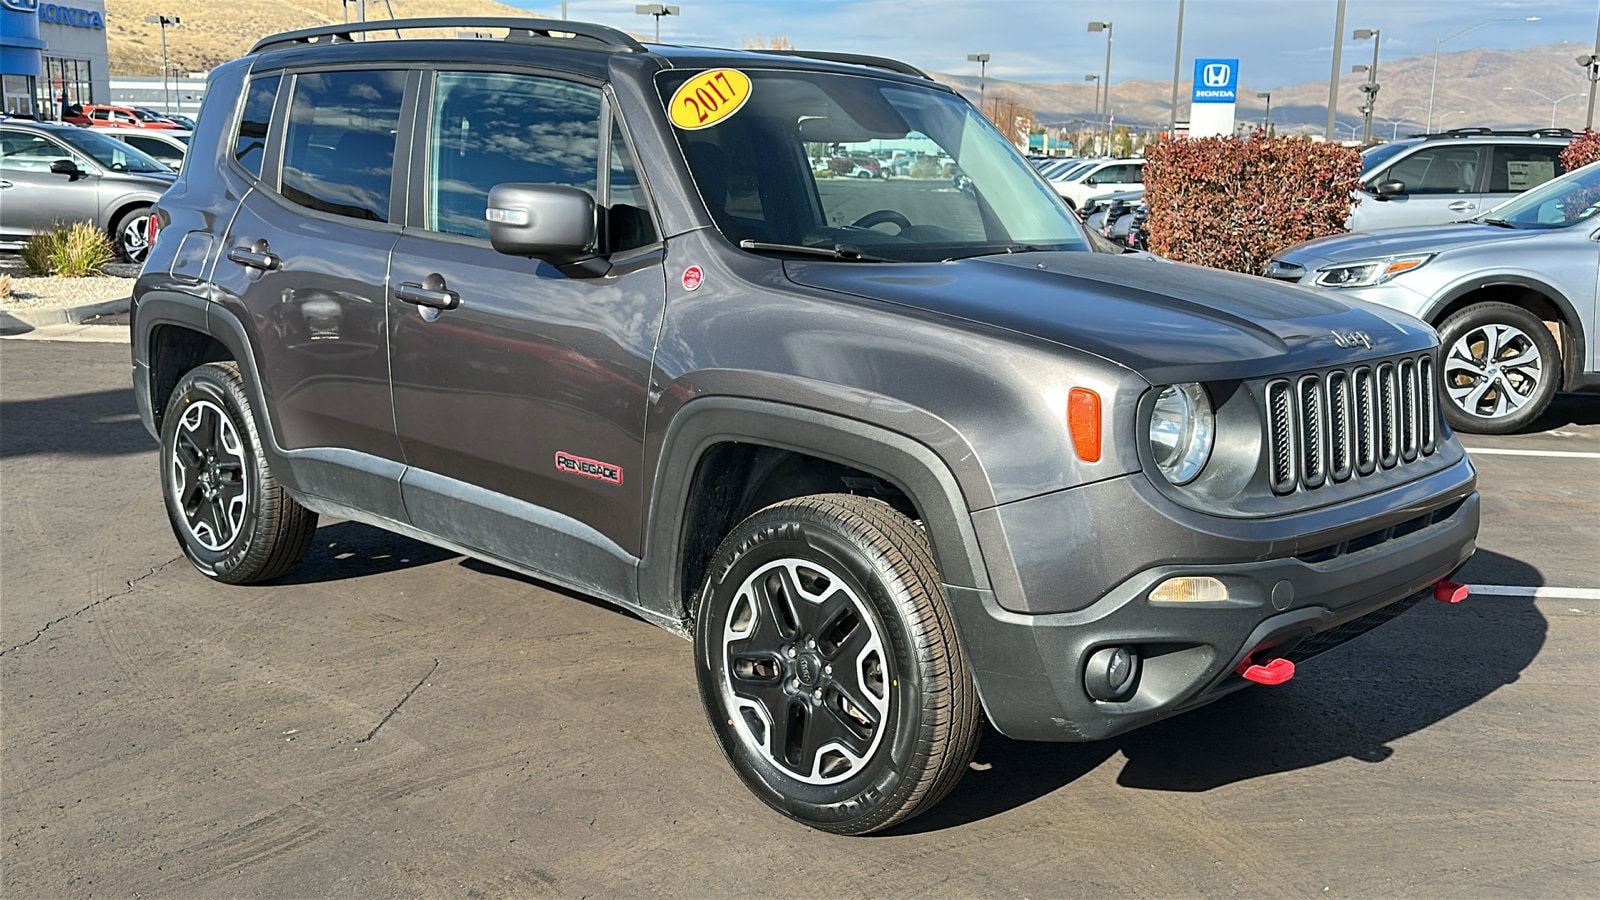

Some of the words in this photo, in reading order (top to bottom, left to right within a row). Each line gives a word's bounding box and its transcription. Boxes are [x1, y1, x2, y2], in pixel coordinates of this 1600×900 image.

[683, 72, 736, 123] 2017
[1196, 90, 1234, 98] HONDA
[1331, 329, 1373, 350] Jeep
[557, 456, 619, 480] RENEGADE
